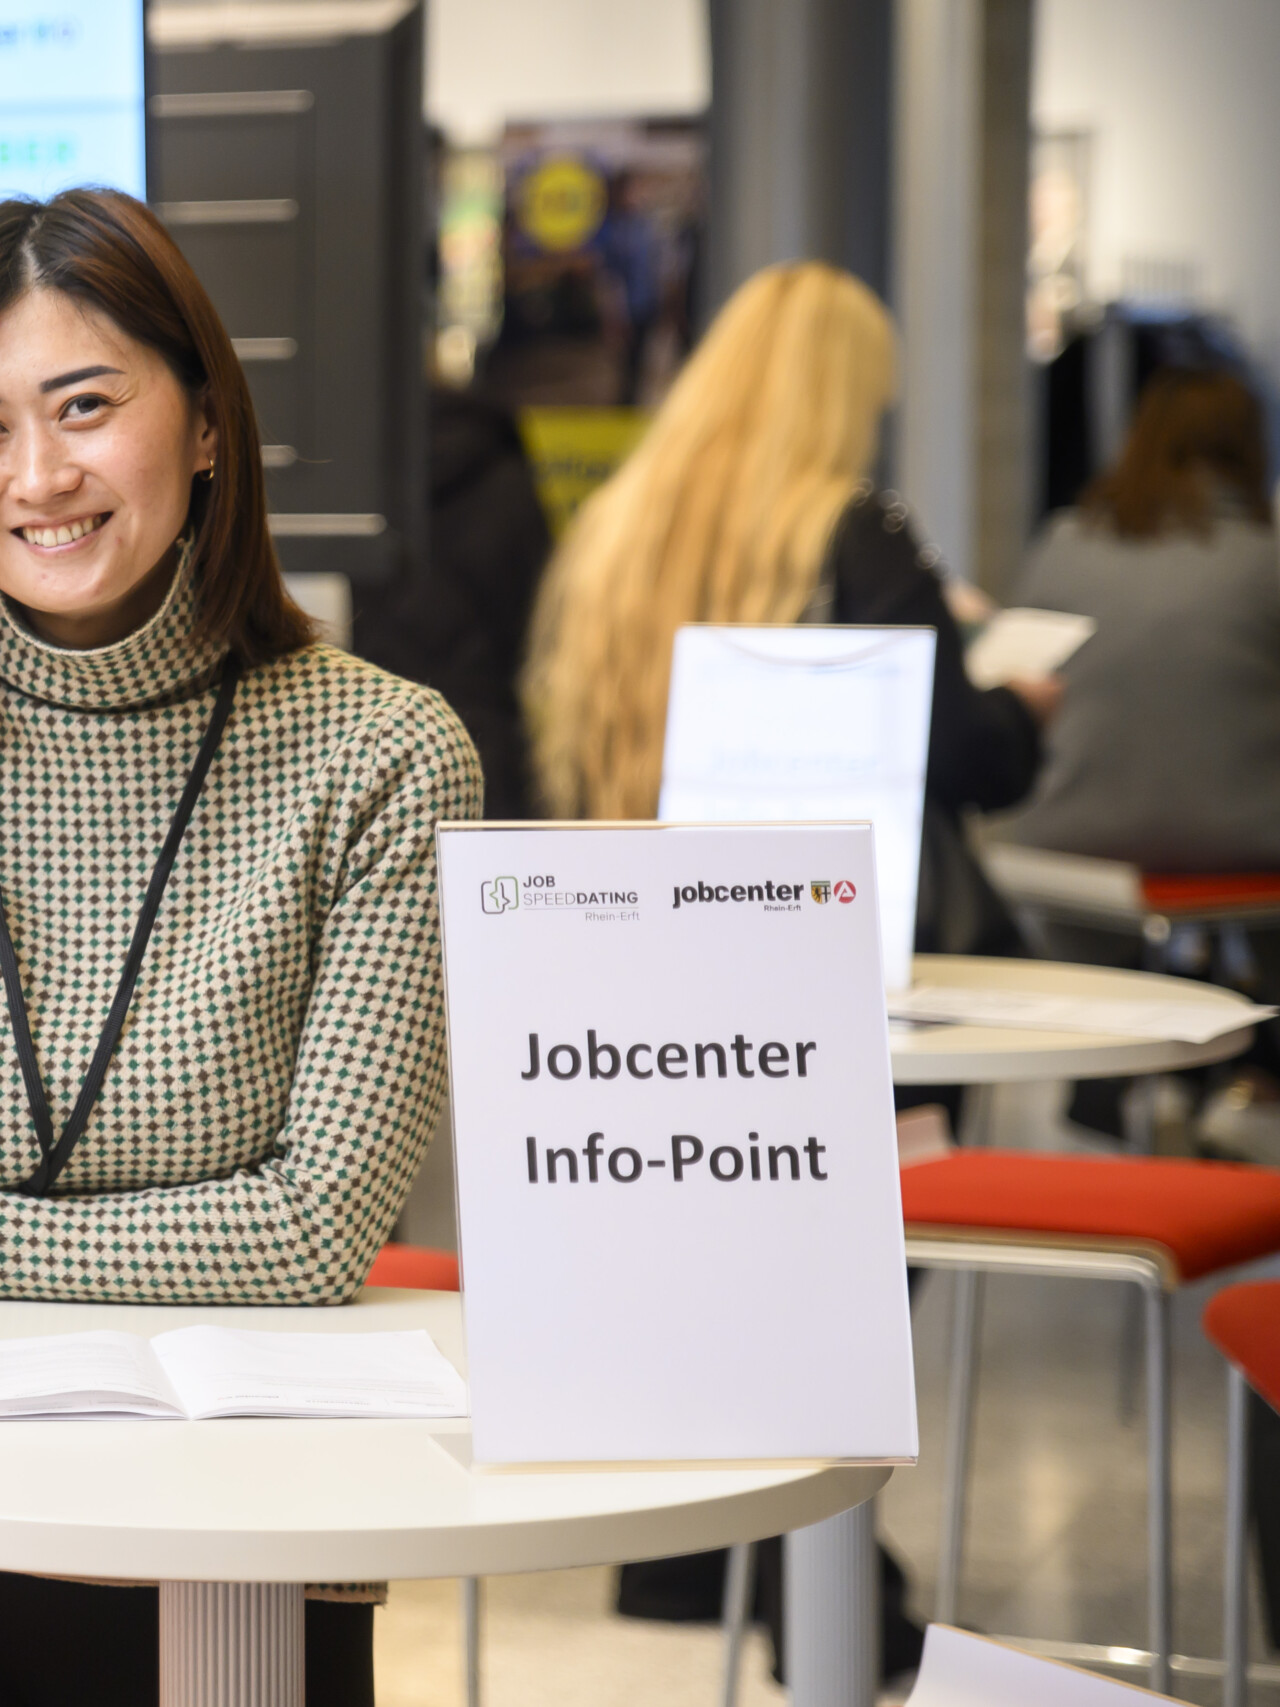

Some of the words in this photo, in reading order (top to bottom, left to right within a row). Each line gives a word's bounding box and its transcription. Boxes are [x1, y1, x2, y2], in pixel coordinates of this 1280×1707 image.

[523, 875, 556, 889] JOB
[523, 891, 639, 906] SPEEDDATING
[672, 880, 805, 910] jobcenter
[763, 904, 803, 912] Rhein-Erft
[584, 911, 641, 922] Rhein-Erft
[520, 1029, 817, 1081] Jobcenter
[526, 1131, 828, 1184] Info-Point
